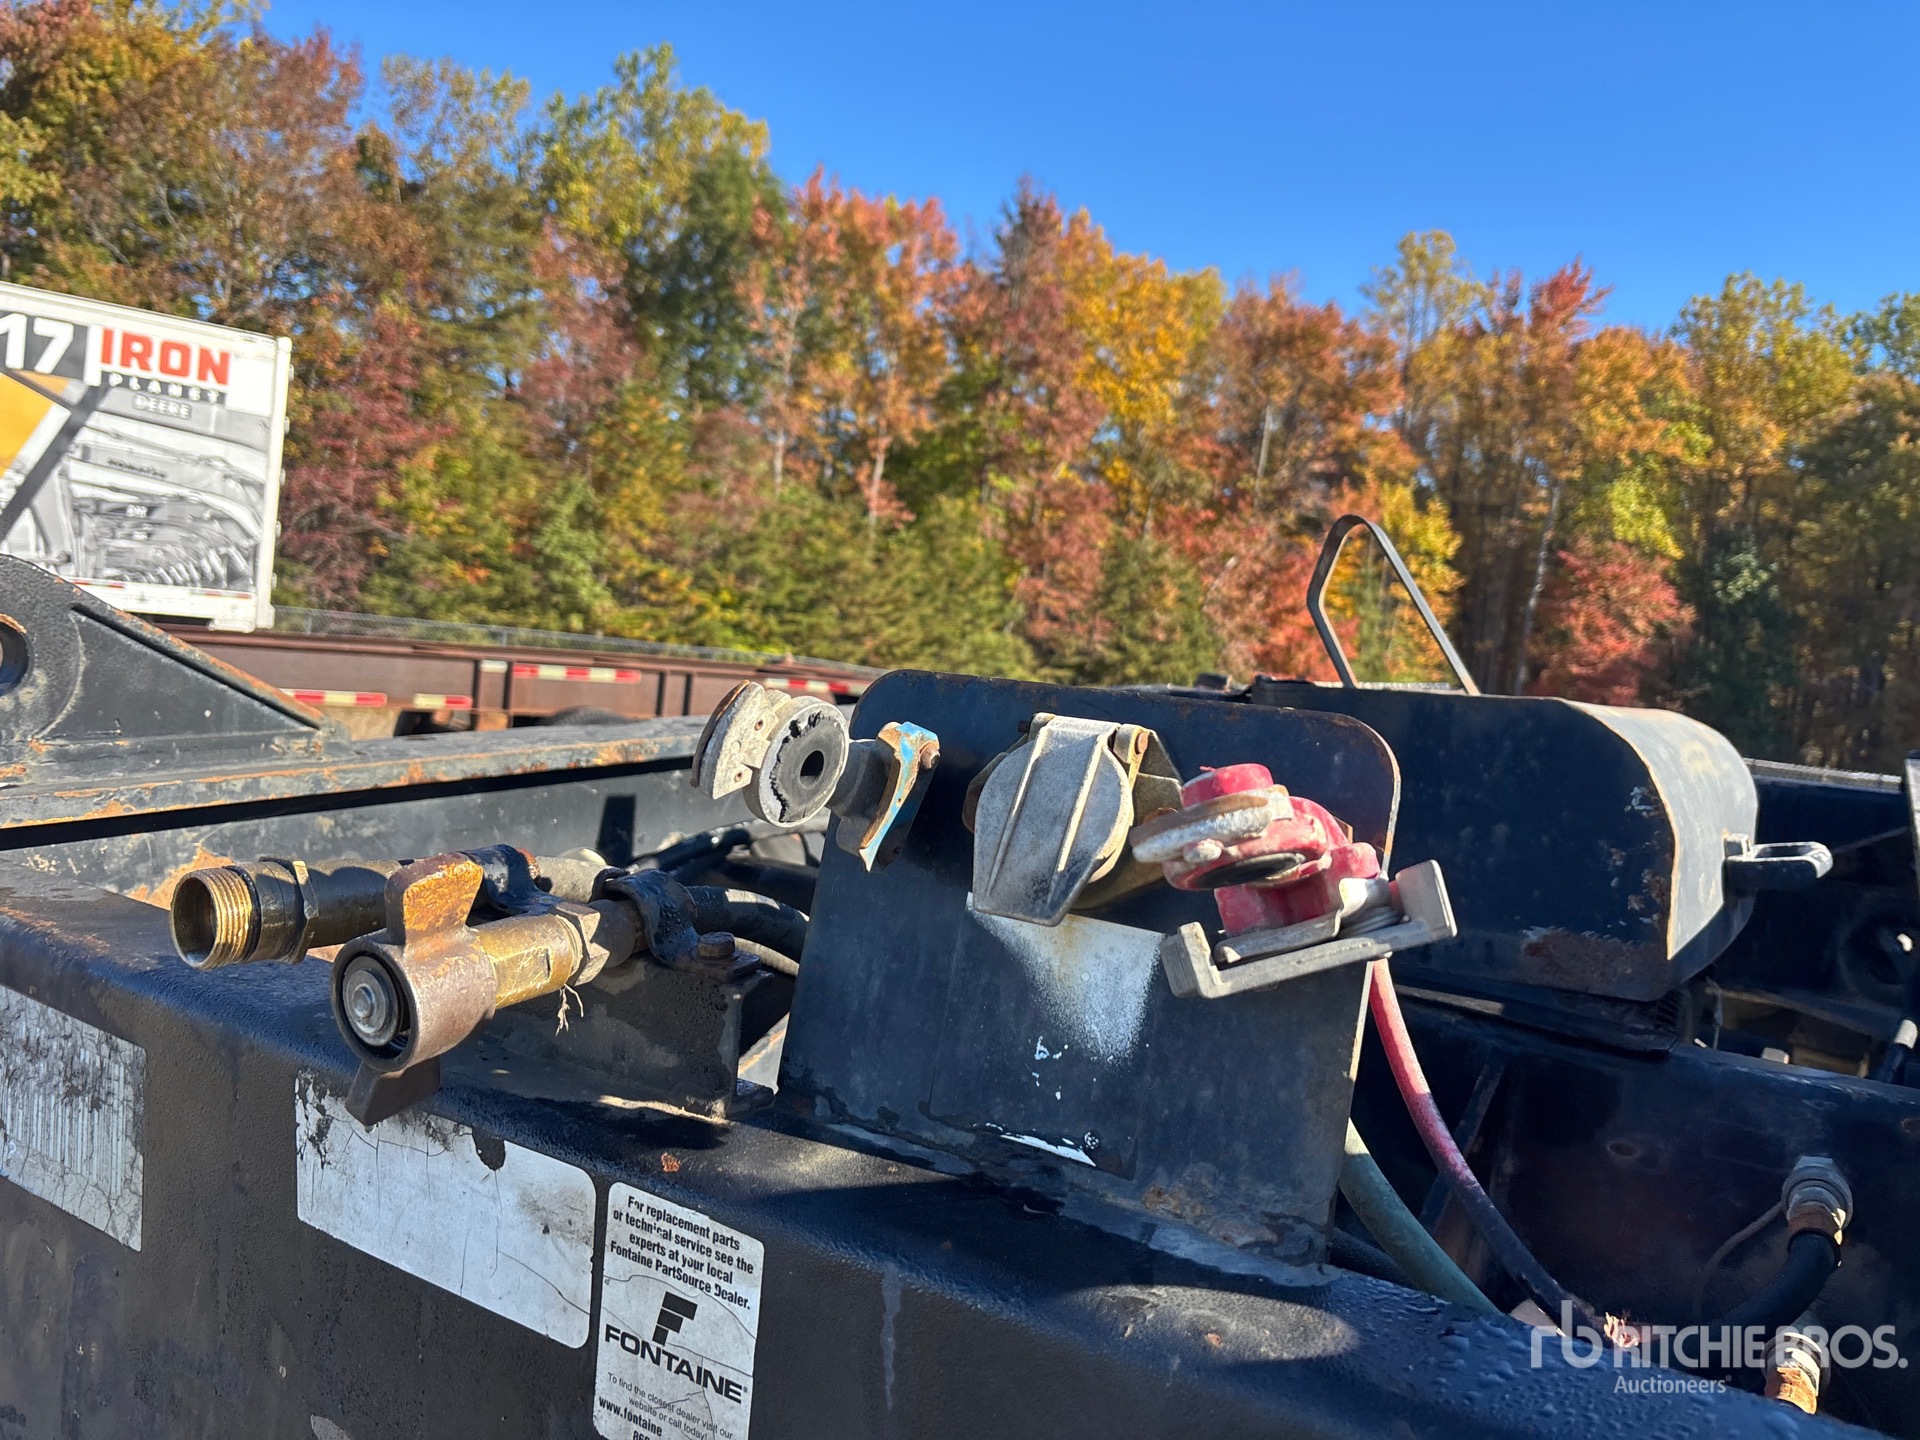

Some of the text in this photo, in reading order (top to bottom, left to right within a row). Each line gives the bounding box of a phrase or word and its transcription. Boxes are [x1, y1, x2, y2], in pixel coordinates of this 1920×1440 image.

[100, 326, 231, 387] IRON
[133, 393, 191, 420] DEERE
[613, 1209, 754, 1274] or technical service see the
[627, 1195, 740, 1250] For replacement parts
[610, 1240, 751, 1310] Fontaine PartSource Dealer.
[629, 1233, 733, 1284] experts at your local
[598, 1396, 663, 1437] www.fontaine
[607, 1371, 734, 1440] To find the closest dealer visit our
[628, 1396, 657, 1417] website
[658, 1412, 668, 1421] or
[668, 1416, 682, 1431] call
